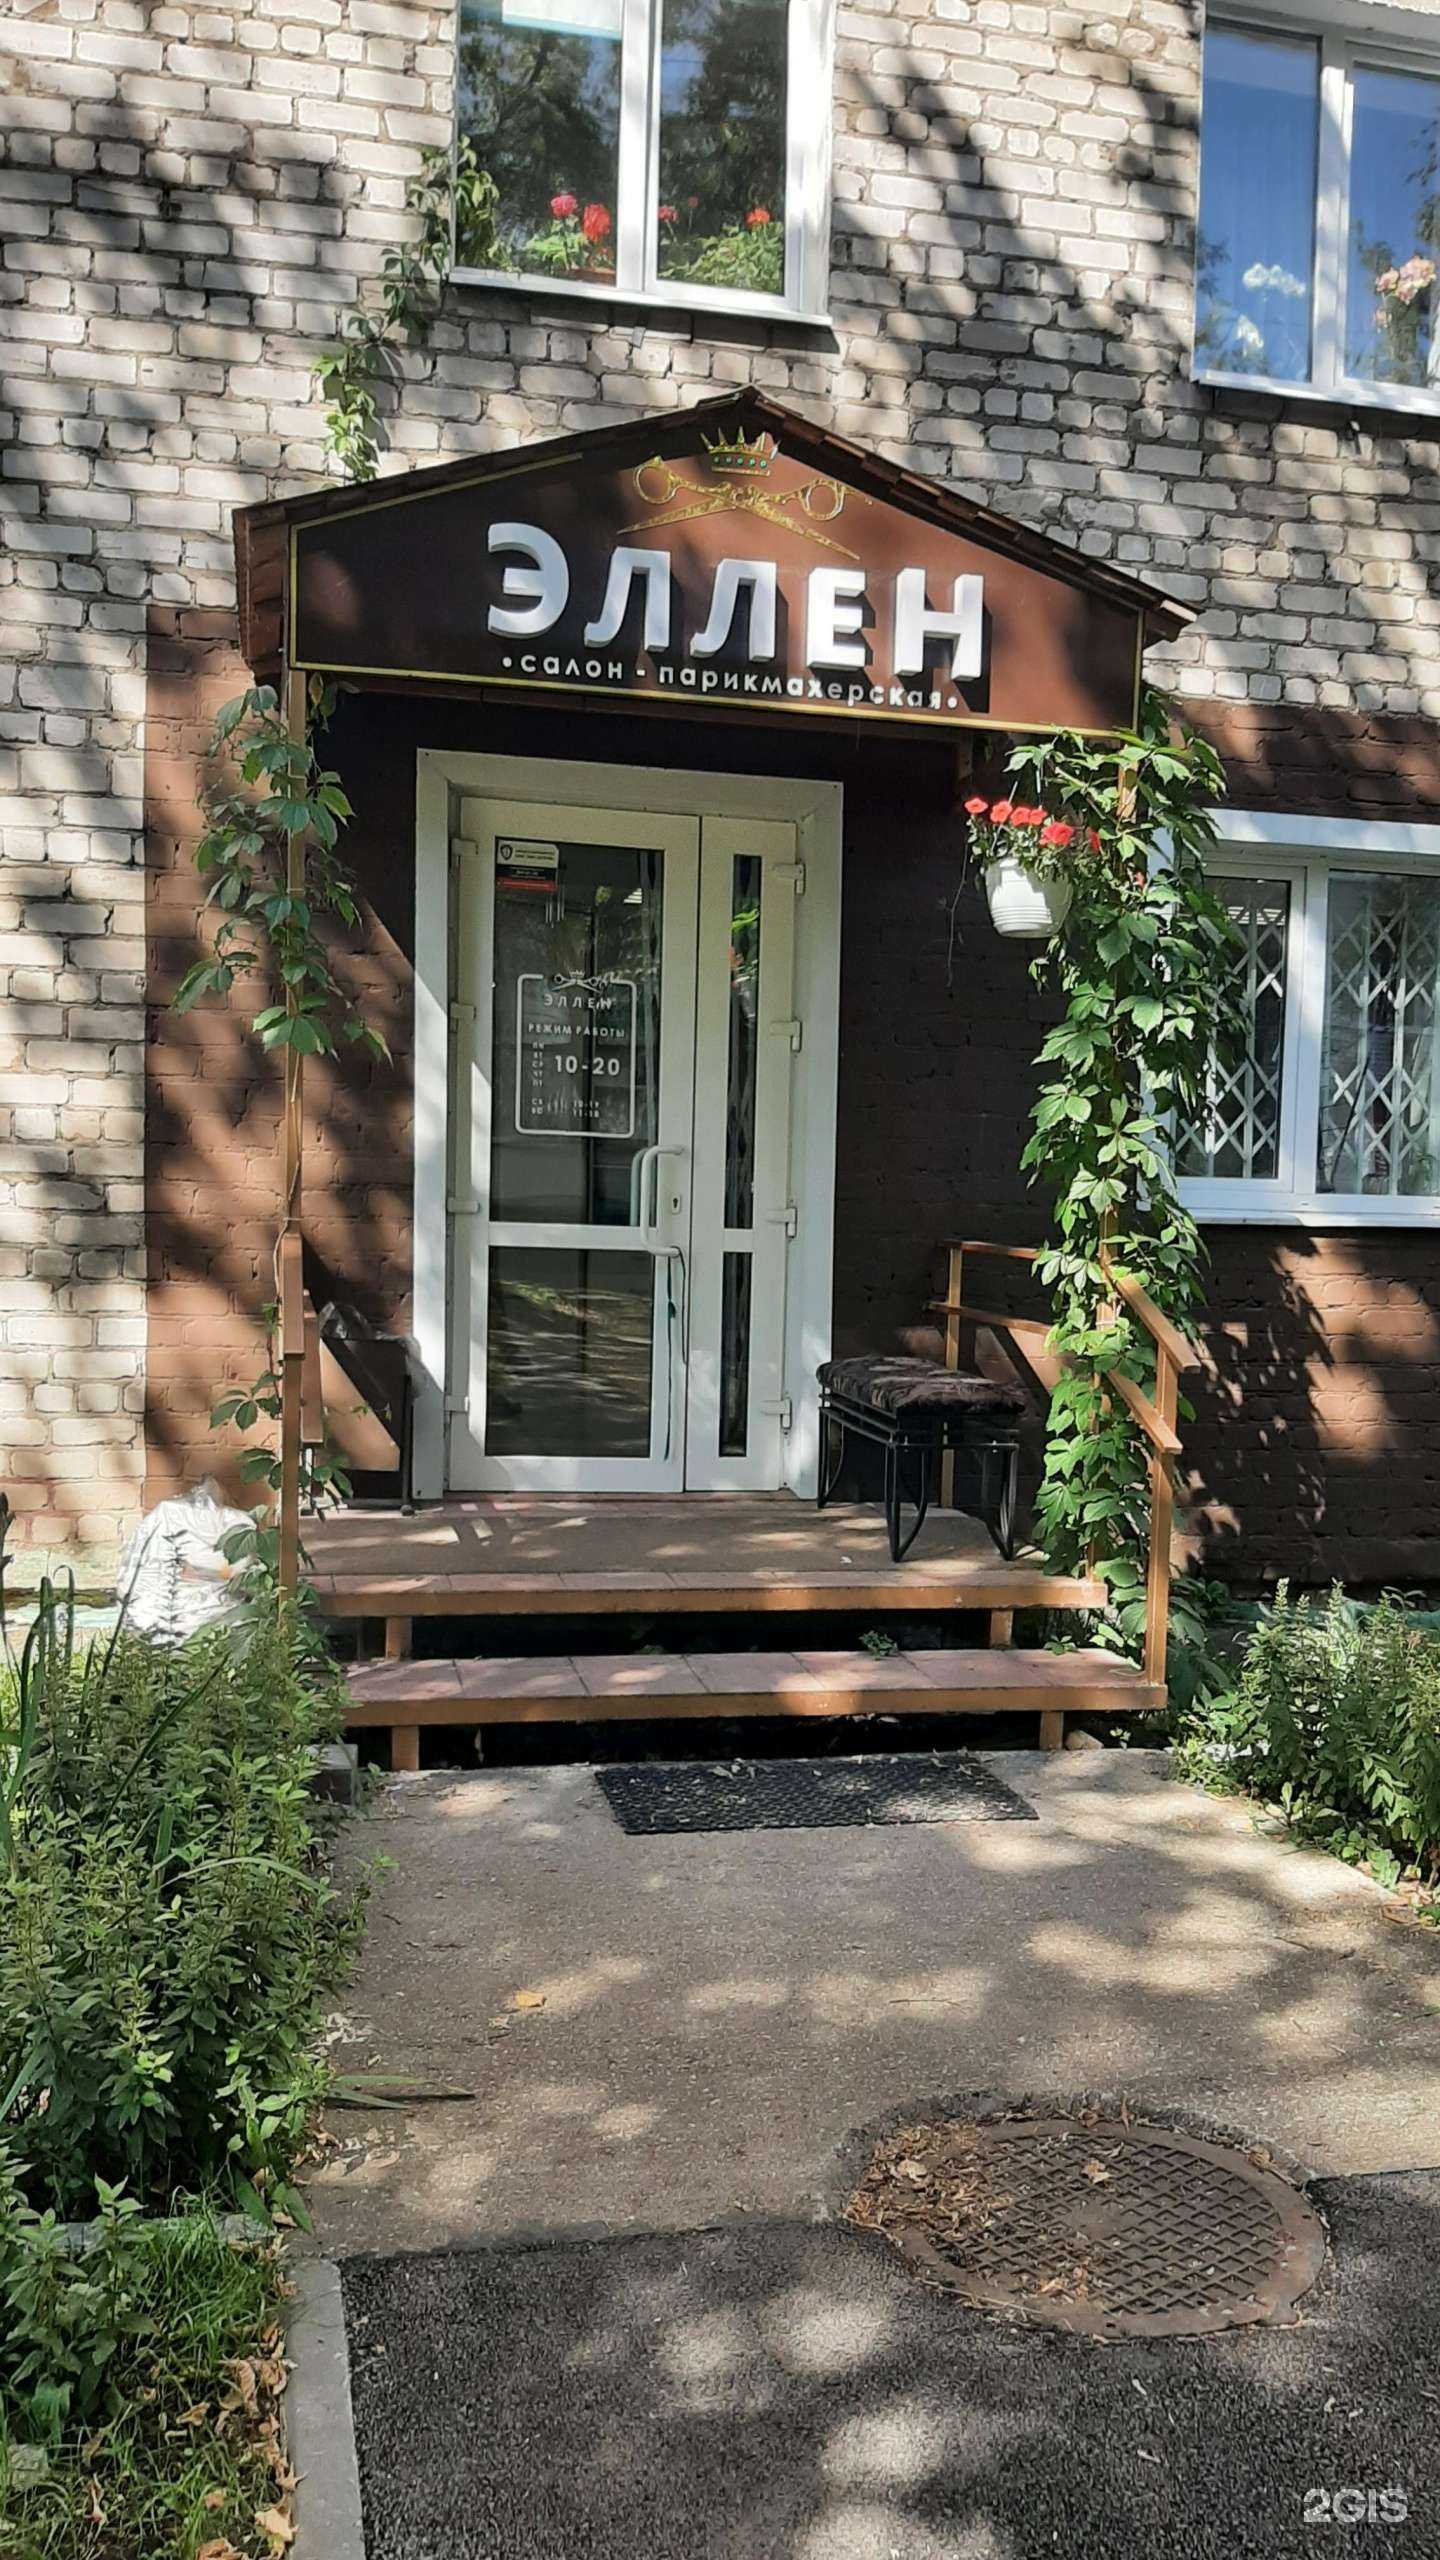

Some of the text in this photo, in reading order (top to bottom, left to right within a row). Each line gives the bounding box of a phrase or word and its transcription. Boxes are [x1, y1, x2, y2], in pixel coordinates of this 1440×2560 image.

[487, 522, 984, 681] ЭЛЛЕН
[543, 993, 612, 1009] ЭЛЛЕН
[528, 1023, 625, 1038] РЕЖИМ РАБОТЫ
[554, 1054, 620, 1076] 10-20
